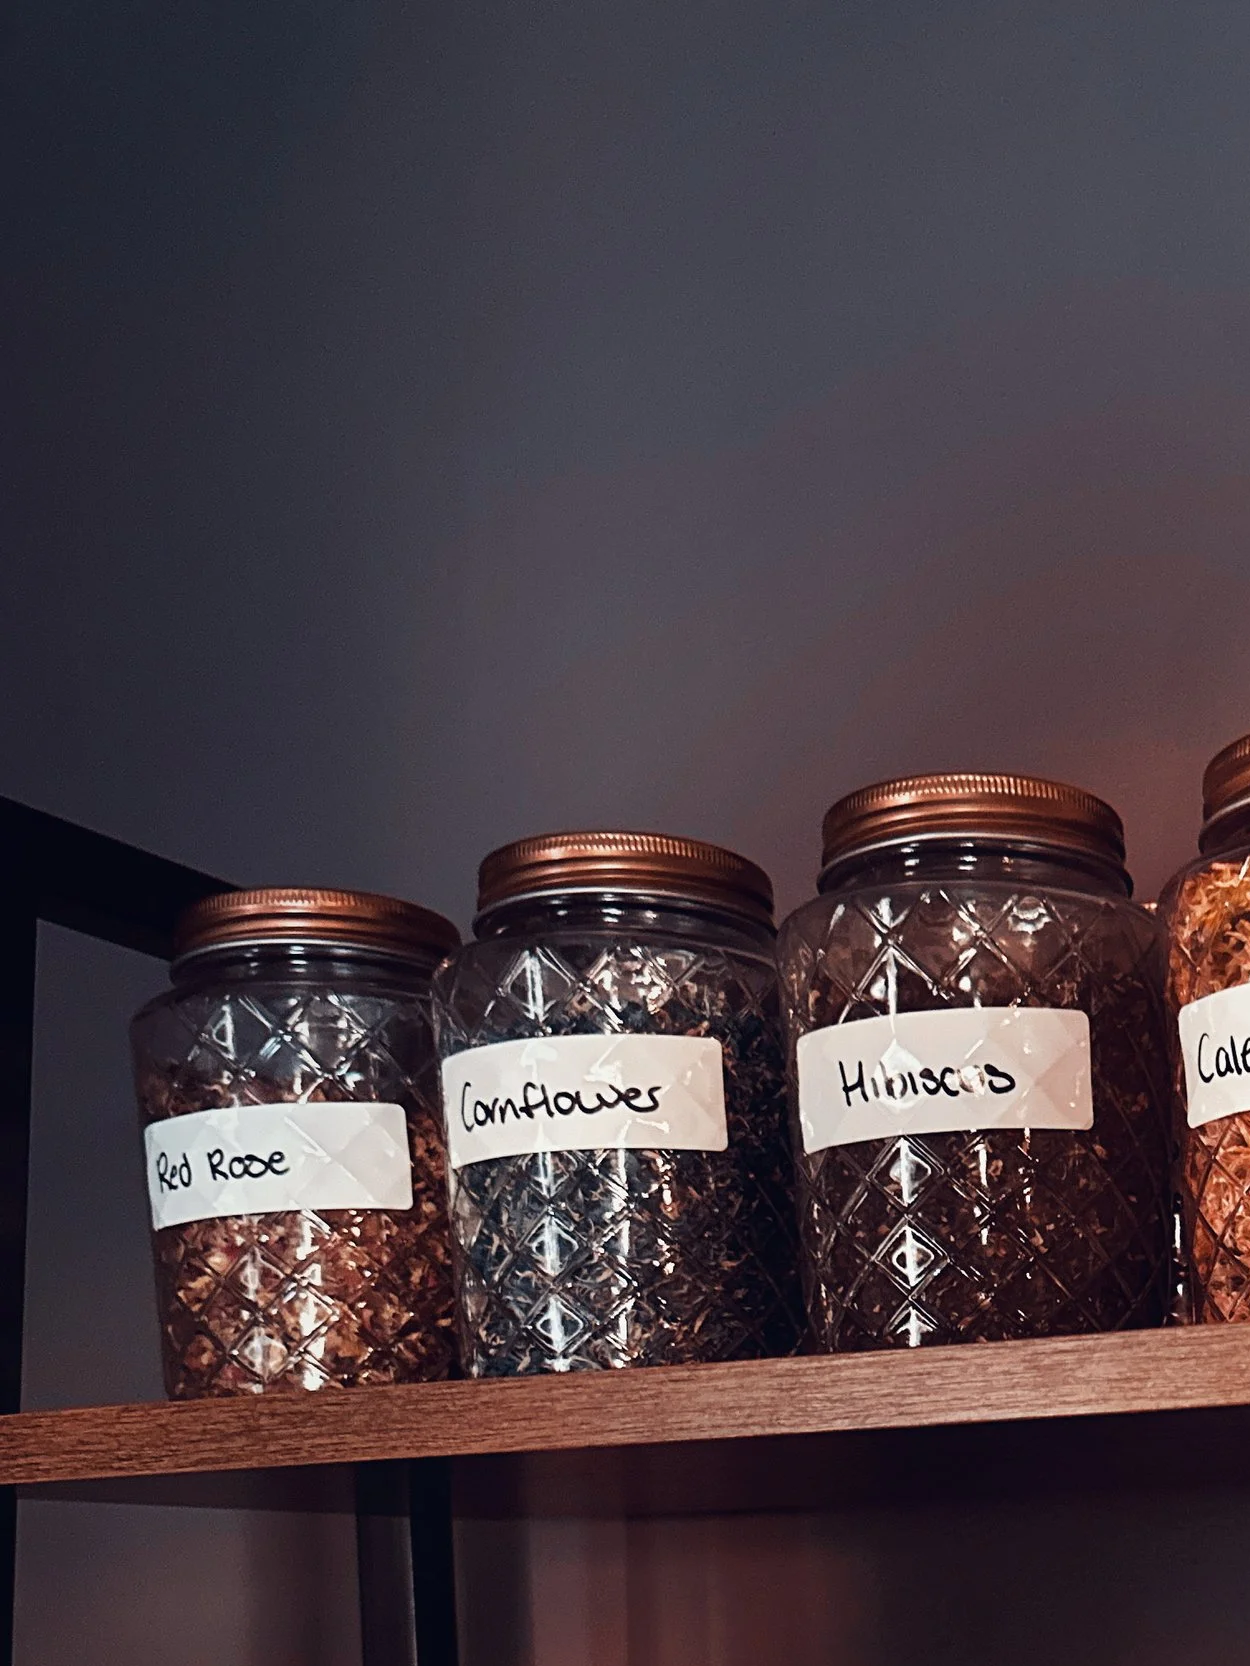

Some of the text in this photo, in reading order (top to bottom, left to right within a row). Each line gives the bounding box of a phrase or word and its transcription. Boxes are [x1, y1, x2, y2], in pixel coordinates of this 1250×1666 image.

[461, 1081, 662, 1132] Cornflower
[838, 1060, 1016, 1107] Hibiscus
[156, 1148, 290, 1193] Red Rose
